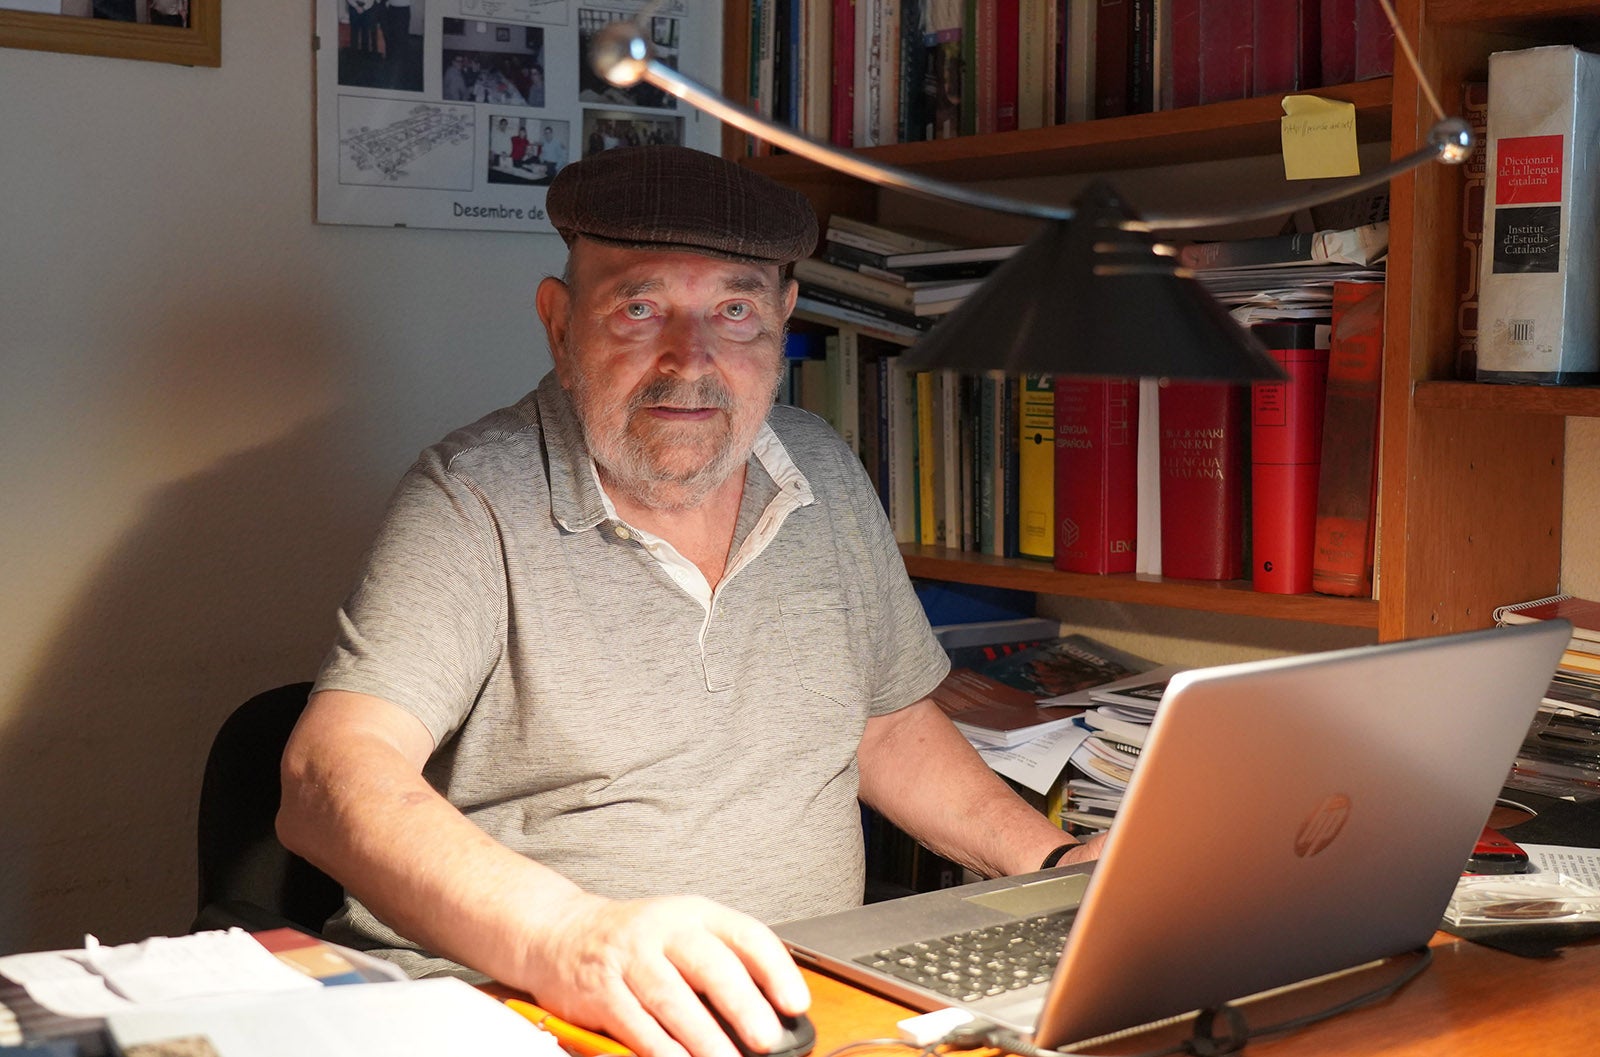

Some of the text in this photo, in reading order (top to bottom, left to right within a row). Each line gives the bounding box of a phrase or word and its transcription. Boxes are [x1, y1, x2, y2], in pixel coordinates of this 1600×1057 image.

[1505, 155, 1554, 166] Diccionari
[1500, 164, 1559, 177] de la llengua
[1508, 175, 1548, 186] catalana
[453, 201, 545, 220] Desembre de
[1508, 225, 1544, 234] Institut
[1503, 234, 1549, 245] d'Estudis
[1504, 244, 1547, 254] Catalans
[1059, 425, 1088, 436] LENGUA
[1056, 438, 1093, 449] ESPAÑOLA
[1167, 438, 1213, 449] ENERAL
[1165, 468, 1224, 480] ATALANA
